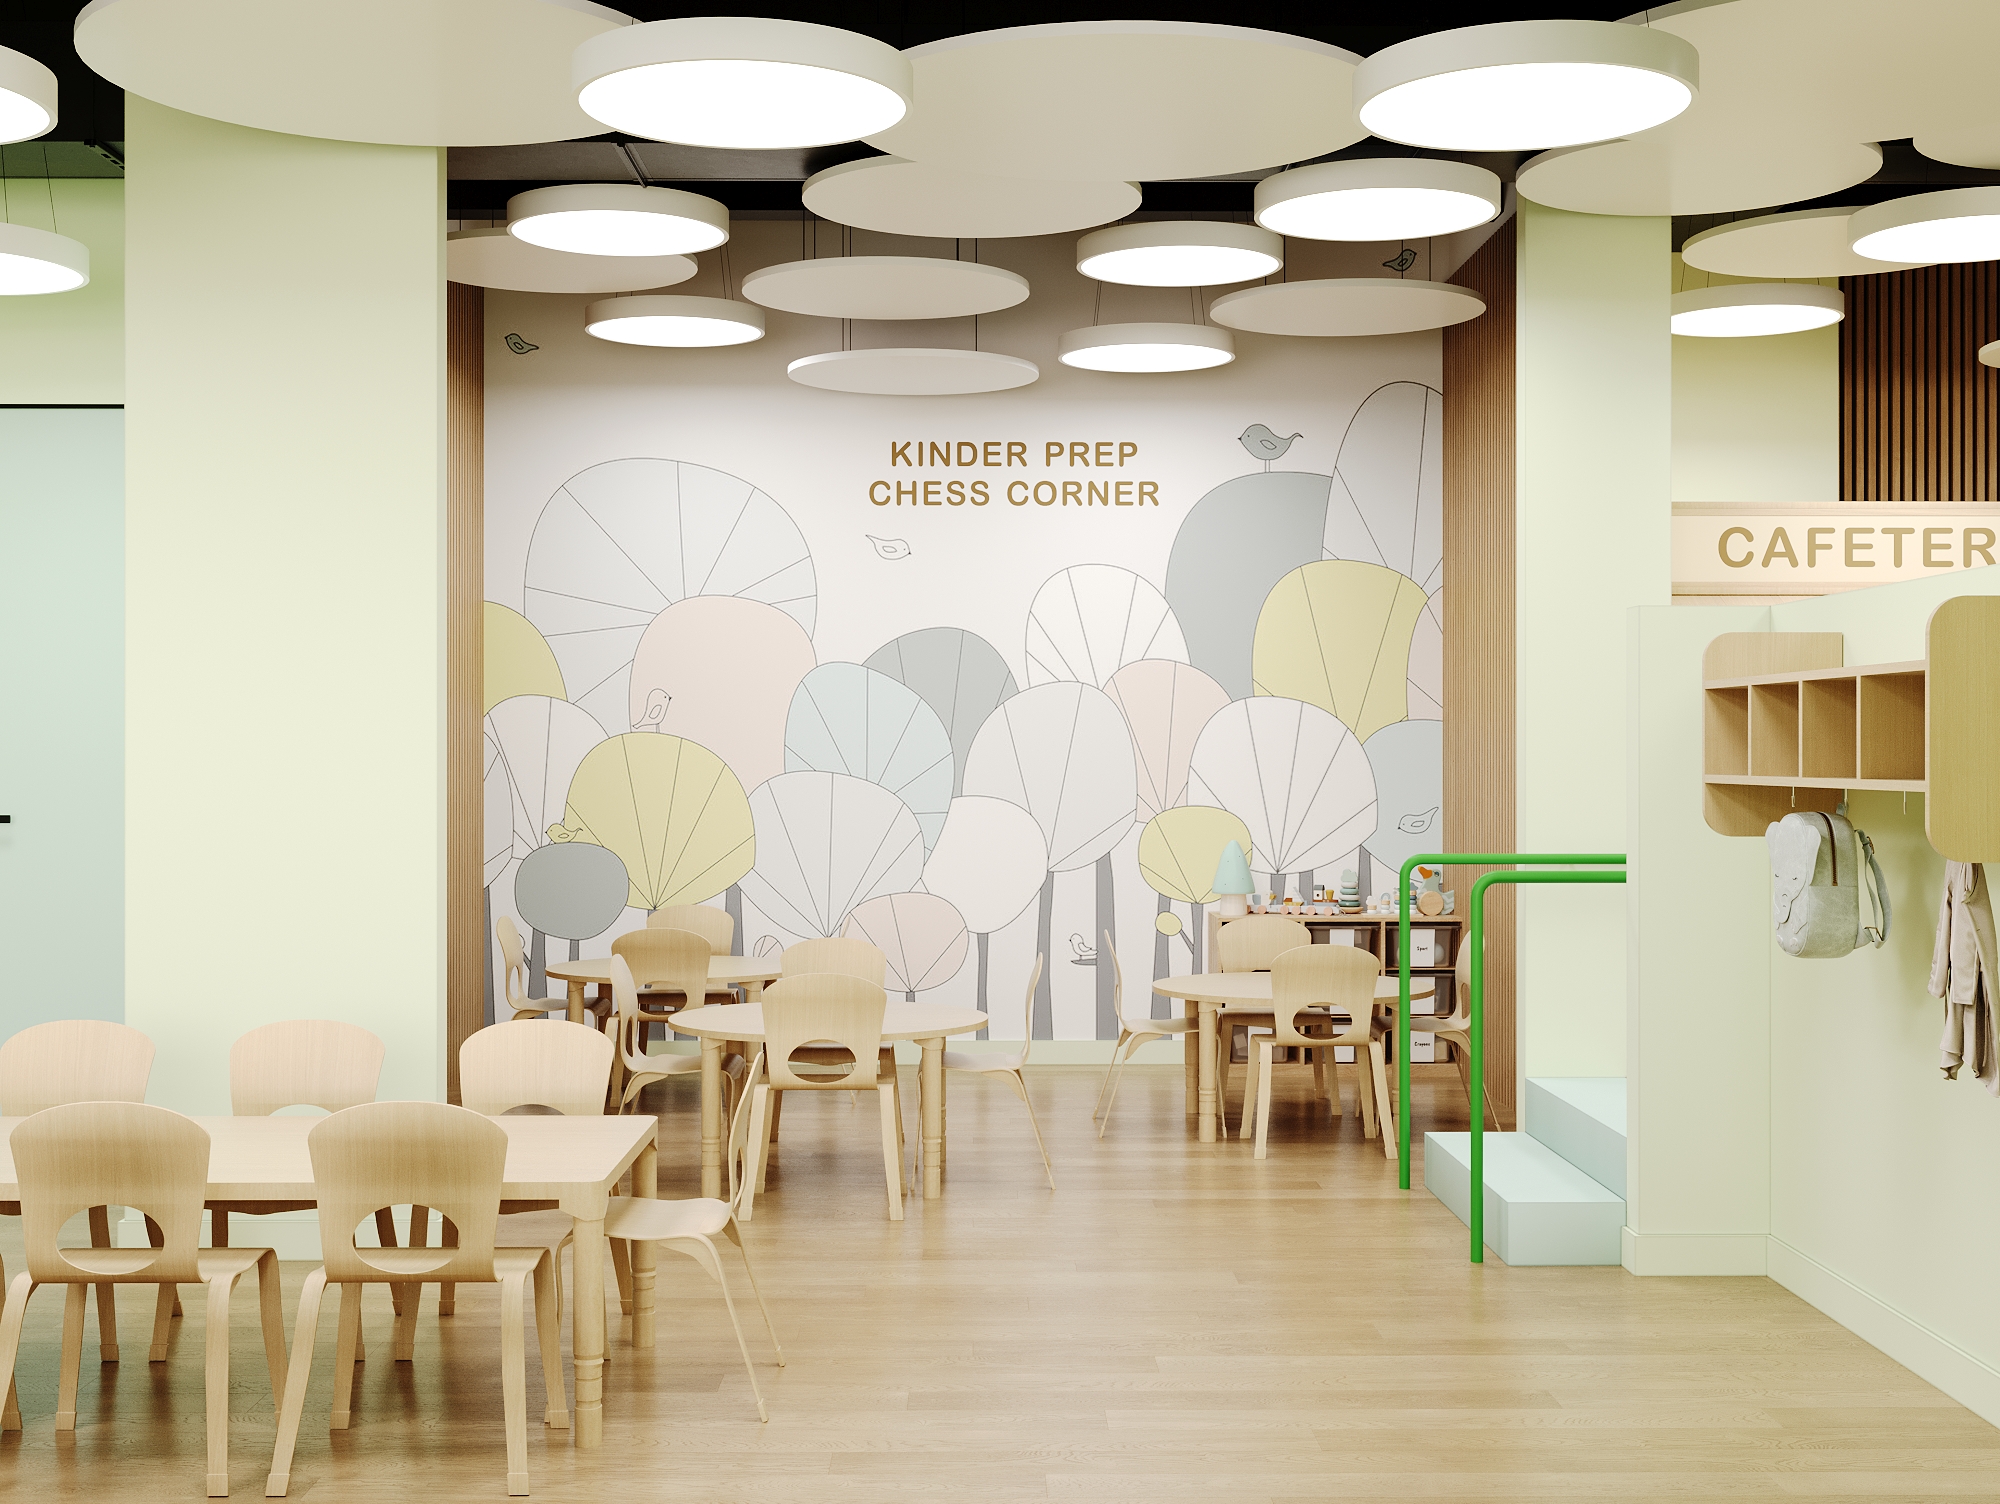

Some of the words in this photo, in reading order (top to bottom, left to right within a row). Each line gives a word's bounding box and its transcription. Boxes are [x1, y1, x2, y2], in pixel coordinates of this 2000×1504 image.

[891, 441, 1028, 467] KINDER
[1045, 441, 1138, 467] PREP
[869, 480, 990, 507] CHESS
[1007, 480, 1159, 507] CORNER
[1717, 526, 1997, 568] CAFETER
